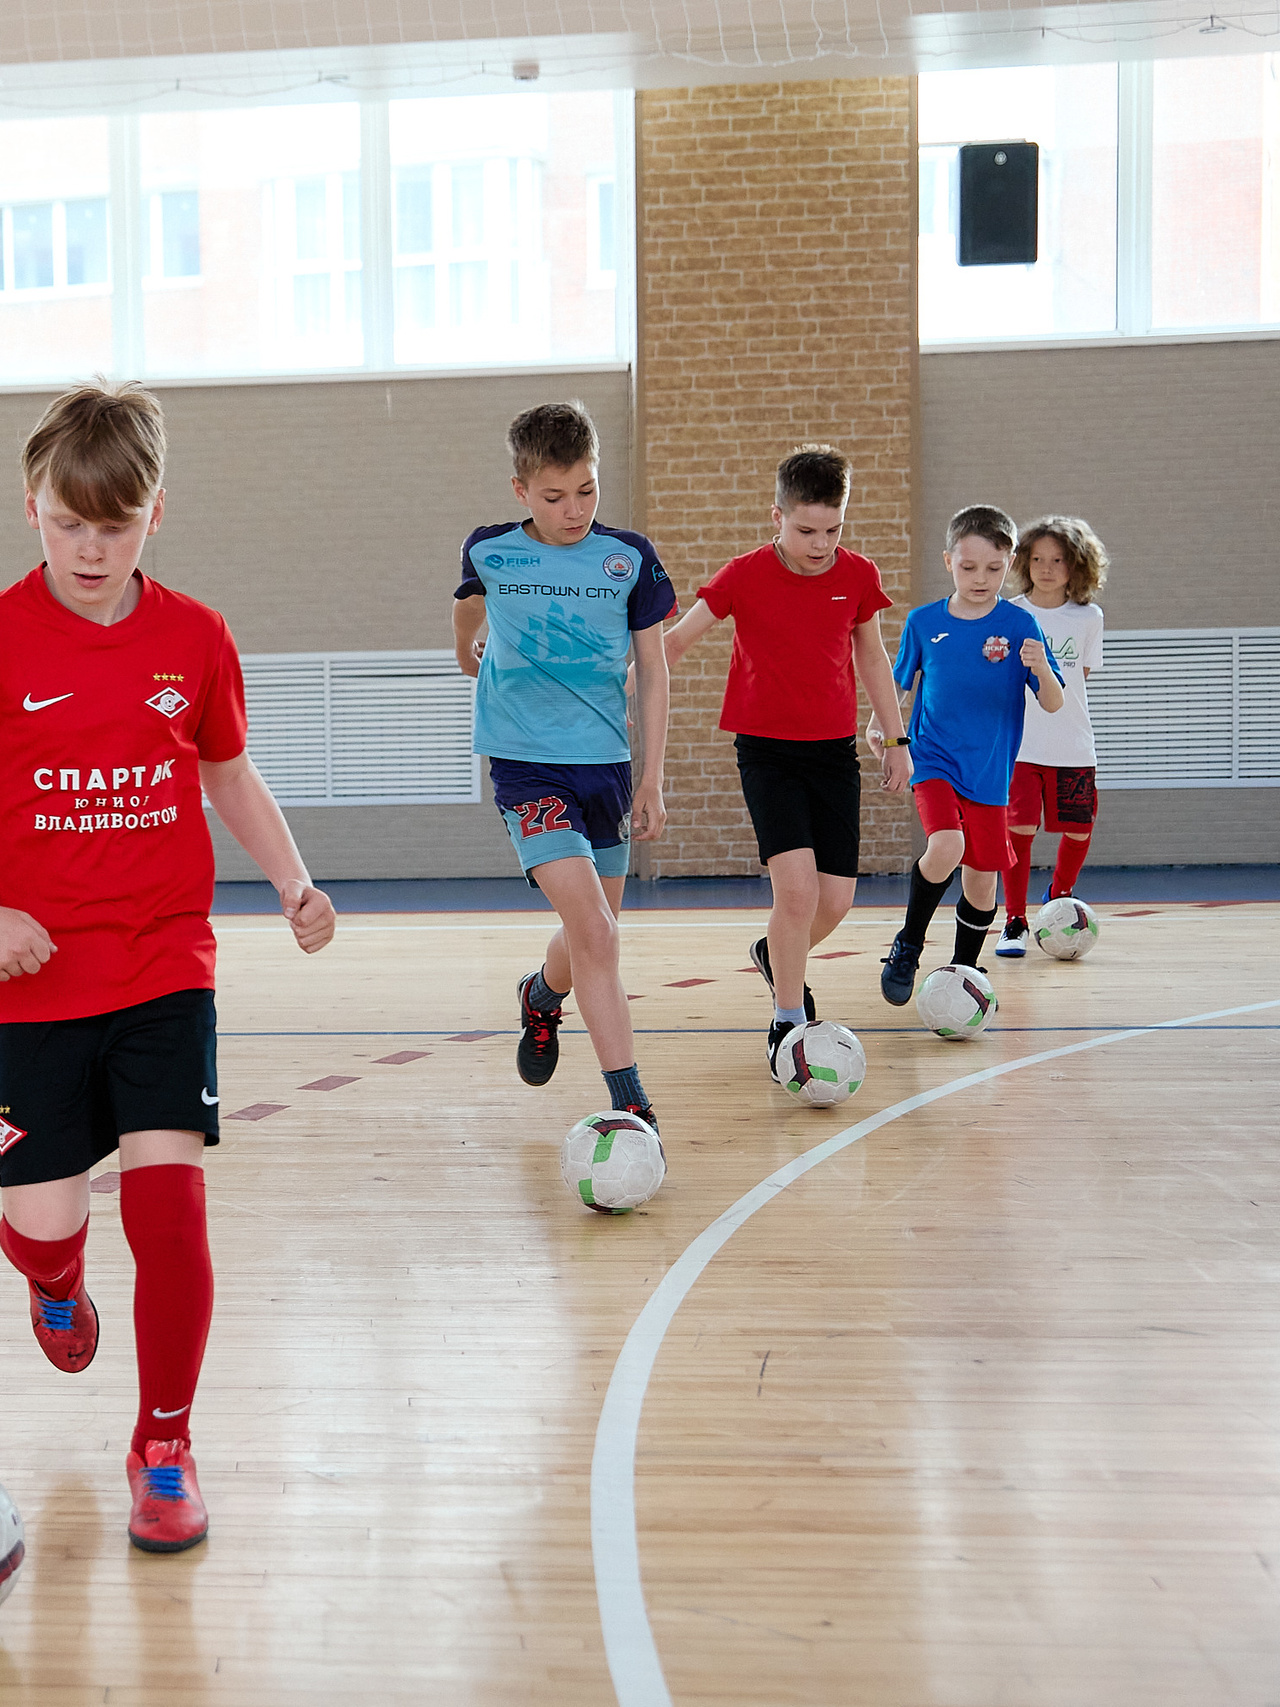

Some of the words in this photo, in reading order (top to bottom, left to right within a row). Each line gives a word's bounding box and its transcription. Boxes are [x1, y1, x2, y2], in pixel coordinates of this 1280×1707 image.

[506, 557, 540, 565] FISH
[498, 584, 580, 598] EASTOWN
[586, 587, 621, 600] CITY
[33, 758, 176, 791] СПАРТАК
[34, 805, 178, 833] ВЛАДИВОСТОК
[513, 795, 572, 840] 22
